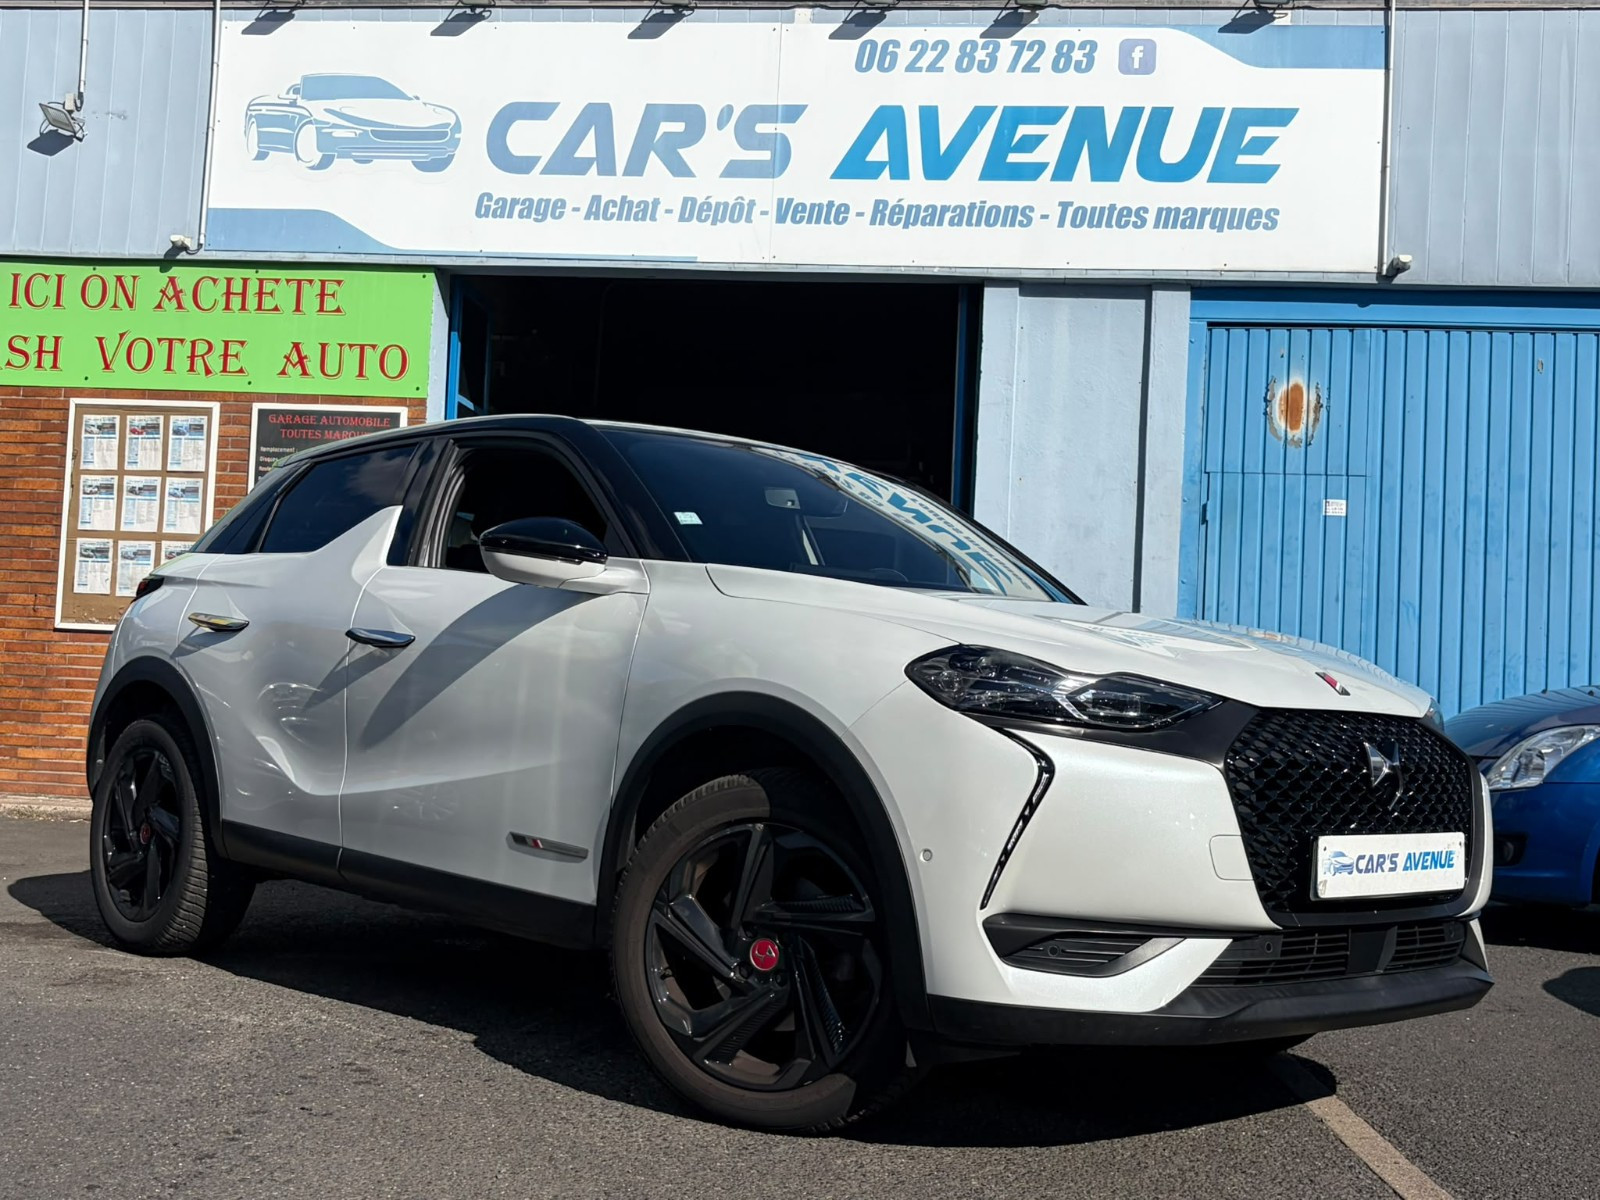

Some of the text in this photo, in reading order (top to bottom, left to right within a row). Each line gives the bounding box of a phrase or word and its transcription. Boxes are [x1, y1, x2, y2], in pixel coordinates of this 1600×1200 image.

[855, 39, 1098, 74] 06 22 83 72 83
[486, 101, 1300, 184] CAR'S AVENUE
[475, 192, 567, 222] Garage
[584, 195, 661, 222] Achat
[678, 196, 756, 226] Dépôt
[775, 198, 851, 225] Vente
[869, 198, 1034, 229] Réparations
[1056, 201, 1148, 229] Toutes
[1152, 207, 1281, 233] marques
[9, 273, 346, 315] ICI ON ACHETE
[0, 330, 410, 381] SH VOTRE AUTO
[268, 414, 391, 427] GARAGE AUTOMOBILE
[280, 428, 373, 440] TOUTES MARQ
[1355, 850, 1456, 874] CAR'S AVENUE
